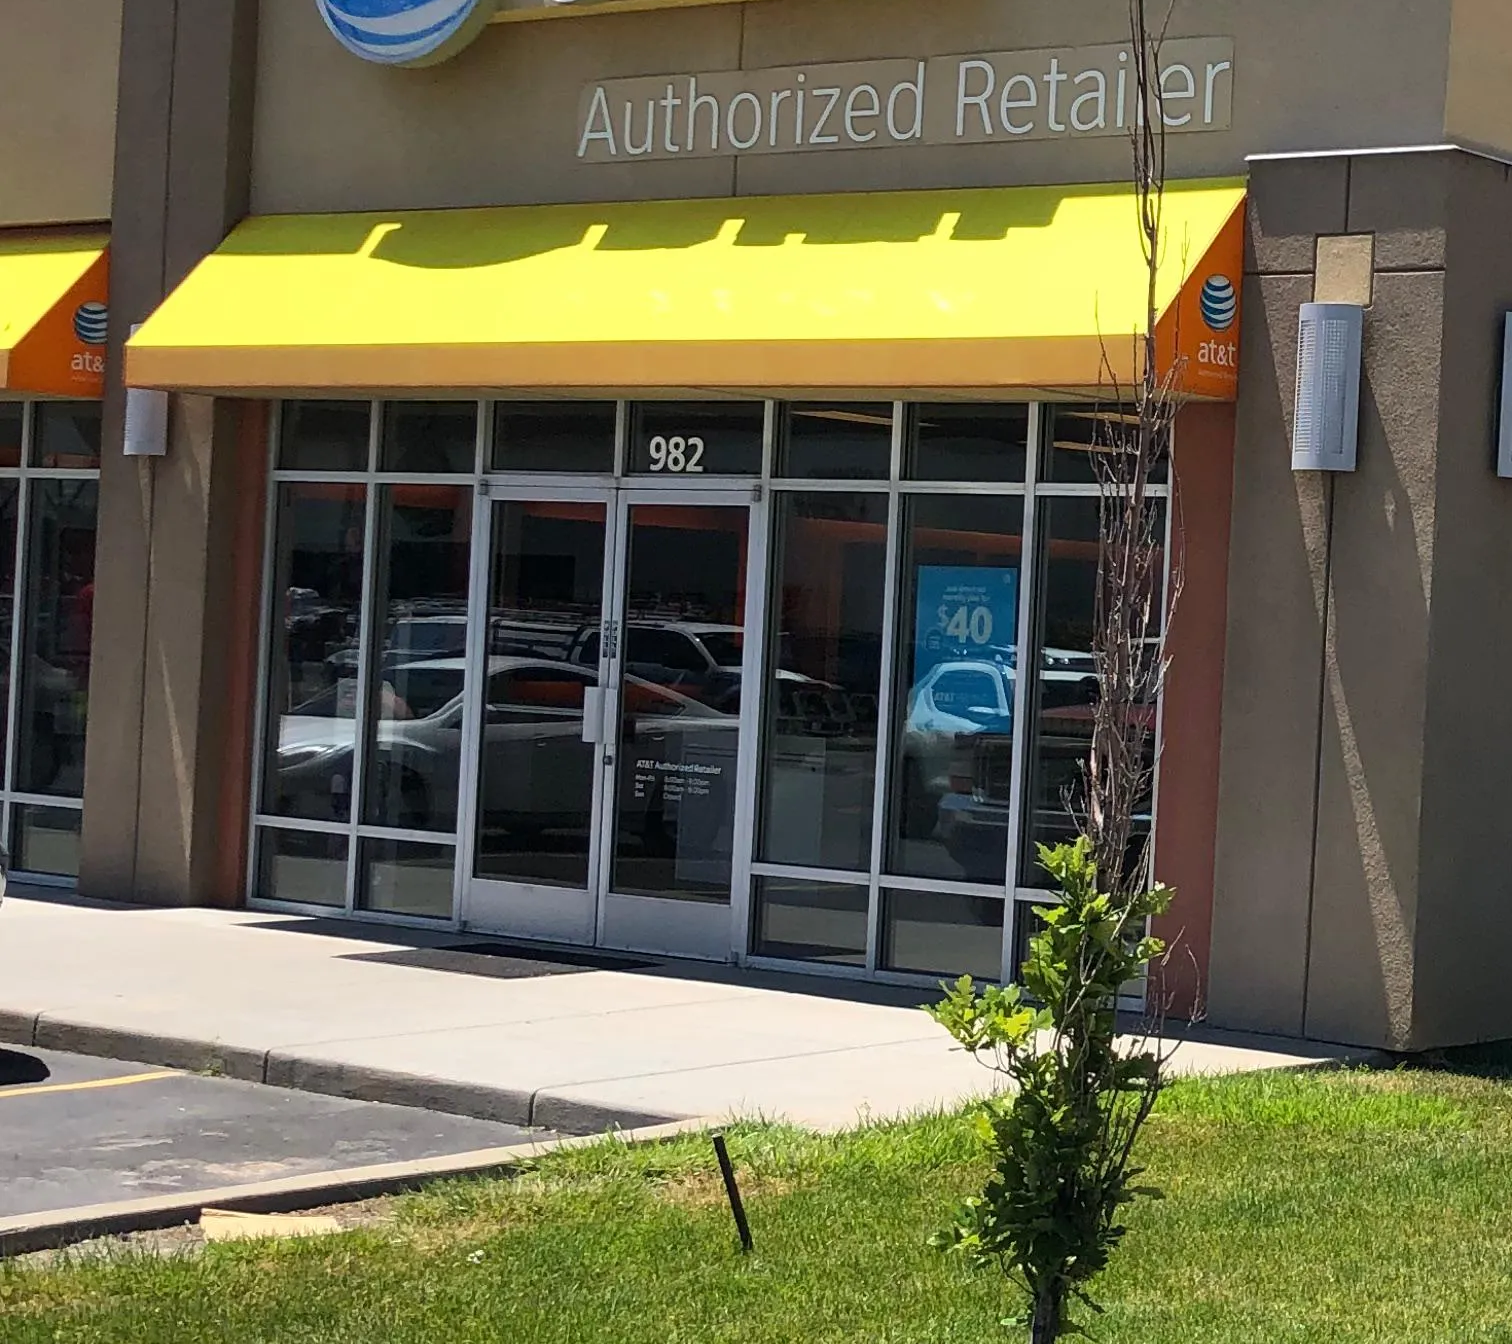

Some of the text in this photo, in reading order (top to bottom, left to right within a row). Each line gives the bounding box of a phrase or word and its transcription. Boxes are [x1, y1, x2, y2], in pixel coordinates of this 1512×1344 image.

[576, 47, 1232, 158] Authorized Retailer
[71, 351, 106, 373] at&
[1197, 339, 1237, 367] at&t
[649, 436, 705, 472] 982
[937, 604, 993, 645] $40
